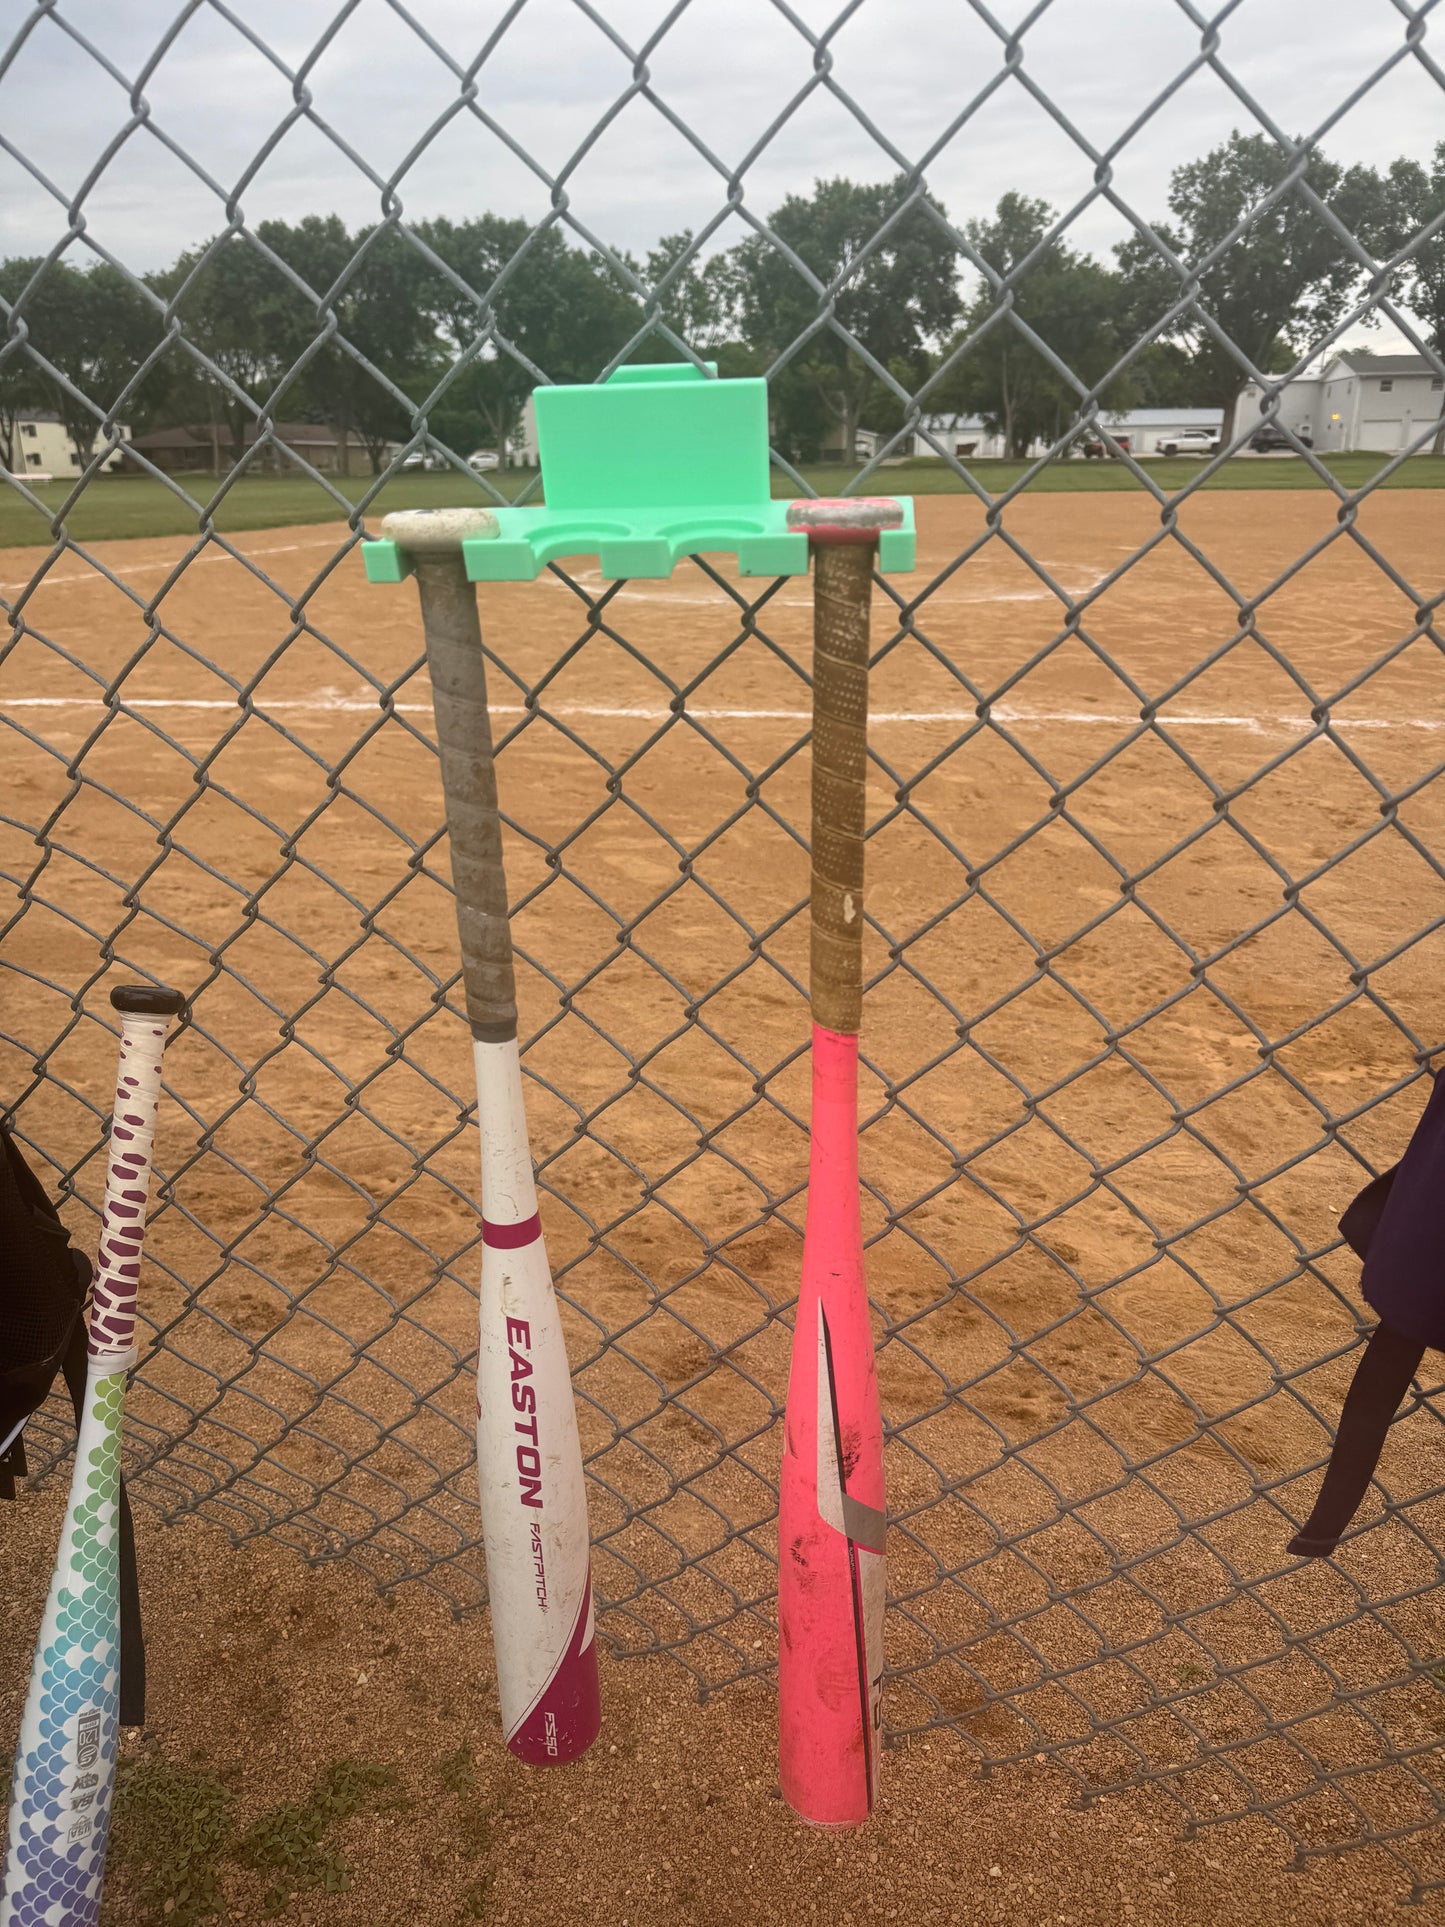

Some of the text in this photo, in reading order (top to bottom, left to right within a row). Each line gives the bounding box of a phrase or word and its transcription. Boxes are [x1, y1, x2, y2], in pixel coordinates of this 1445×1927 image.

[506, 1316, 543, 1509] EASTON
[530, 1522, 547, 1608] FASTPITCH
[544, 1711, 558, 1756] FS50
